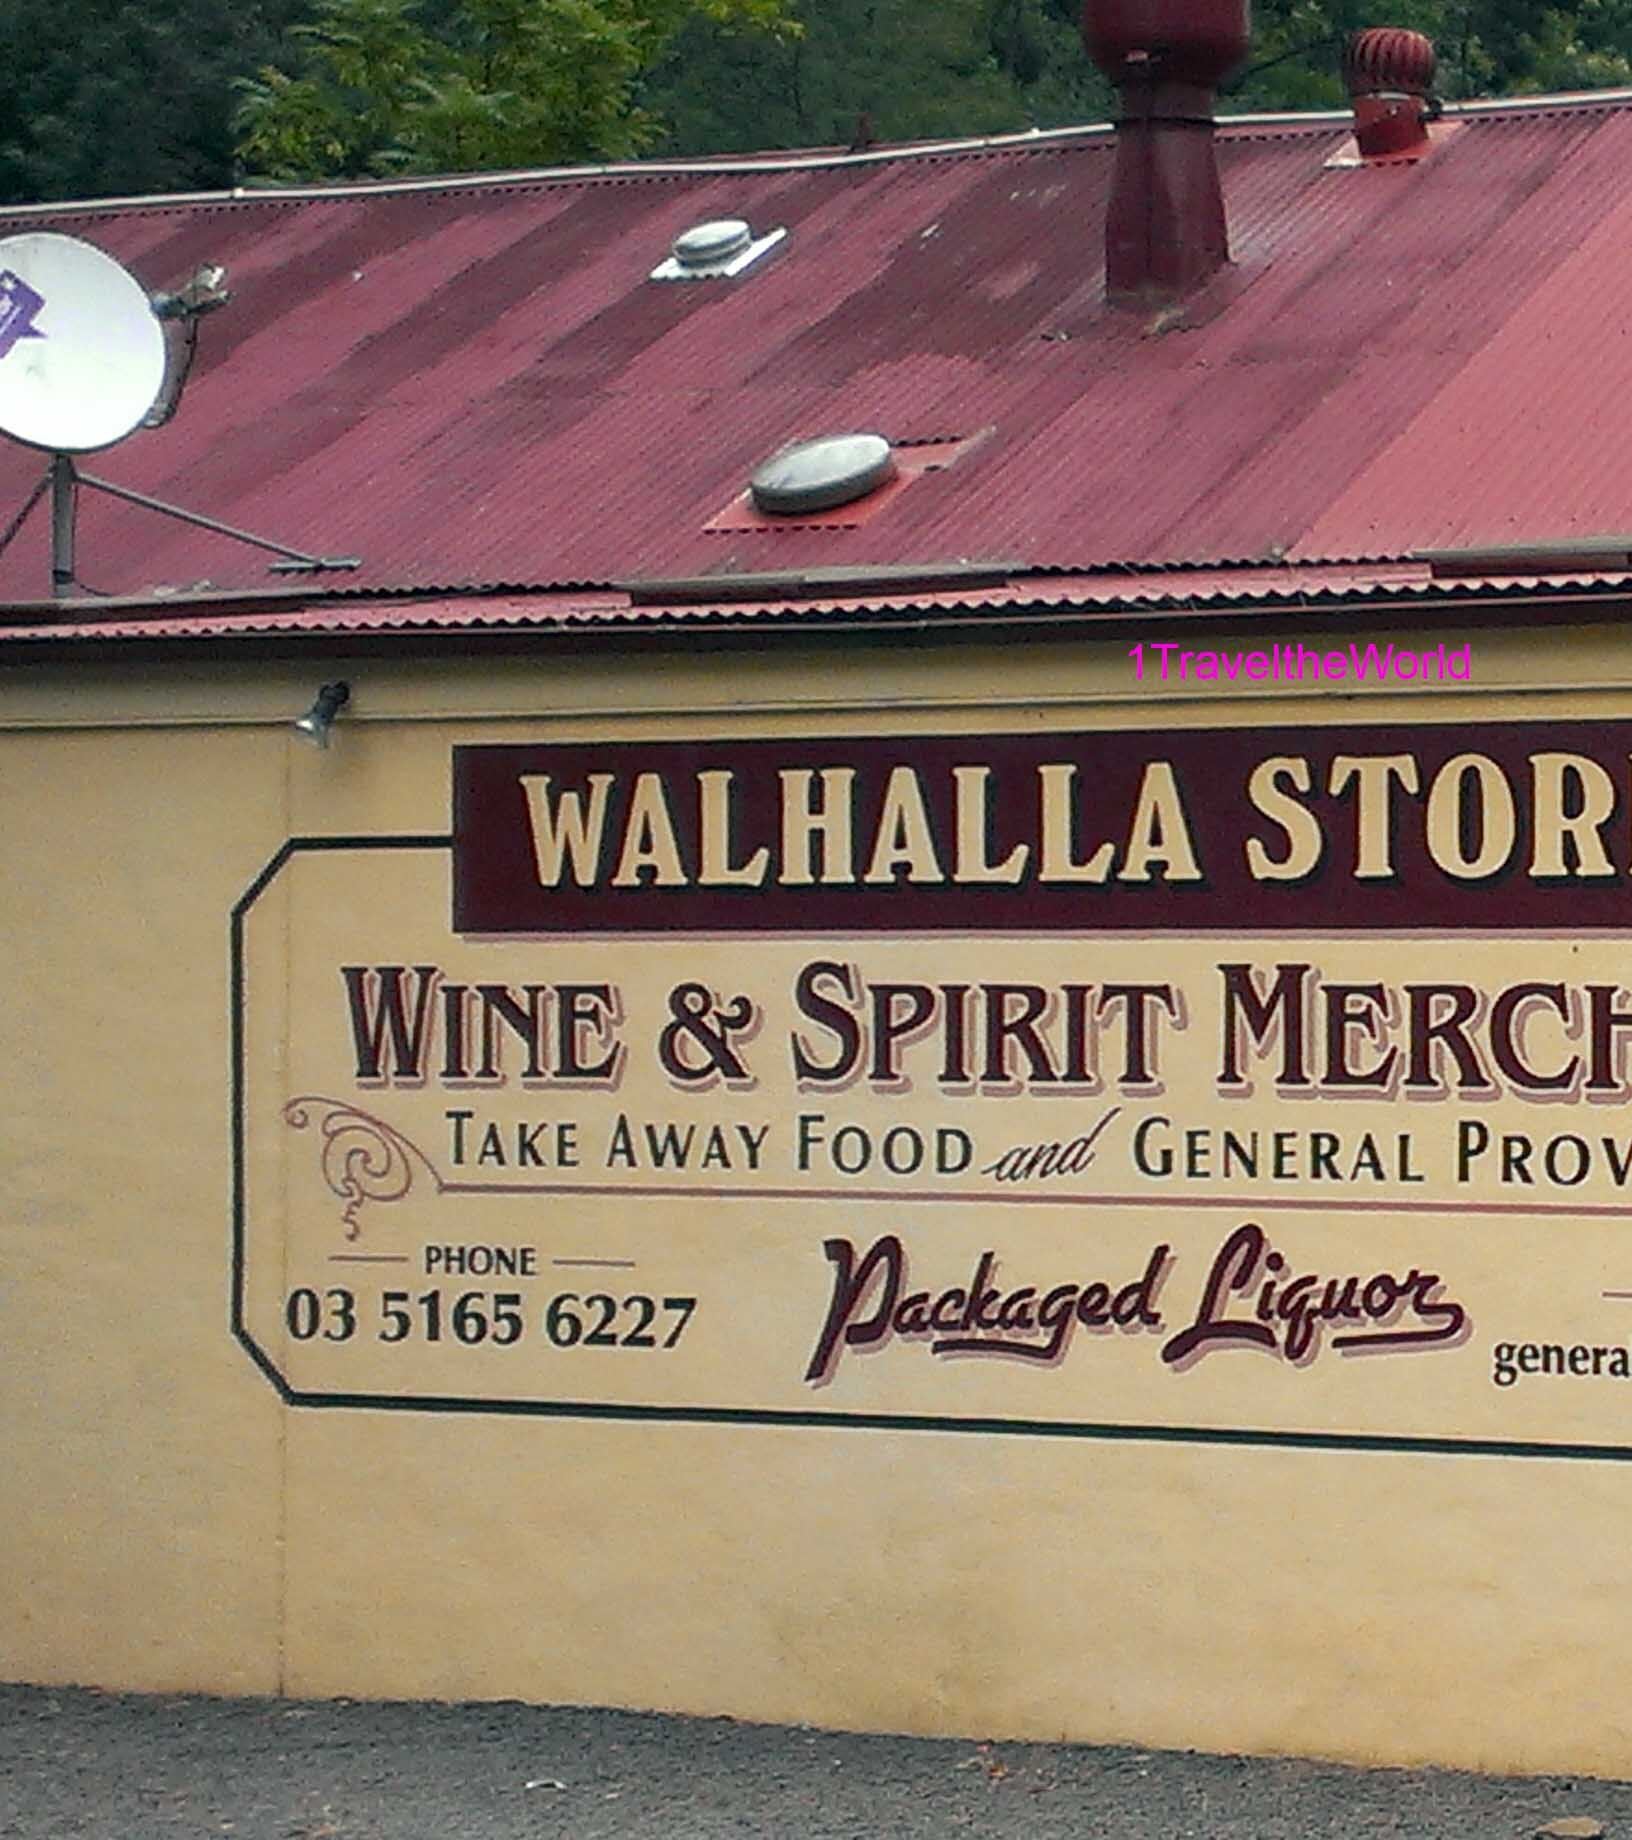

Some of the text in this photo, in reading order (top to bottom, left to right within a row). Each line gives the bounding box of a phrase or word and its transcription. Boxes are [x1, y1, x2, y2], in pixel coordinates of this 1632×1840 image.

[519, 760, 1204, 888] WALHALLA
[341, 964, 624, 1084] WINE
[657, 980, 756, 1084] &
[791, 960, 1182, 1088] SPIRIT
[445, 1110, 579, 1167] TAKE
[606, 1113, 770, 1170] AWAY
[797, 1114, 973, 1175] FOOD
[980, 1106, 1122, 1182] and
[1133, 1115, 1425, 1183] GENERAL
[424, 1245, 537, 1277] PHONE
[804, 1221, 1470, 1386] Packaged Liquor
[285, 1288, 699, 1349] 03 5165 6227
